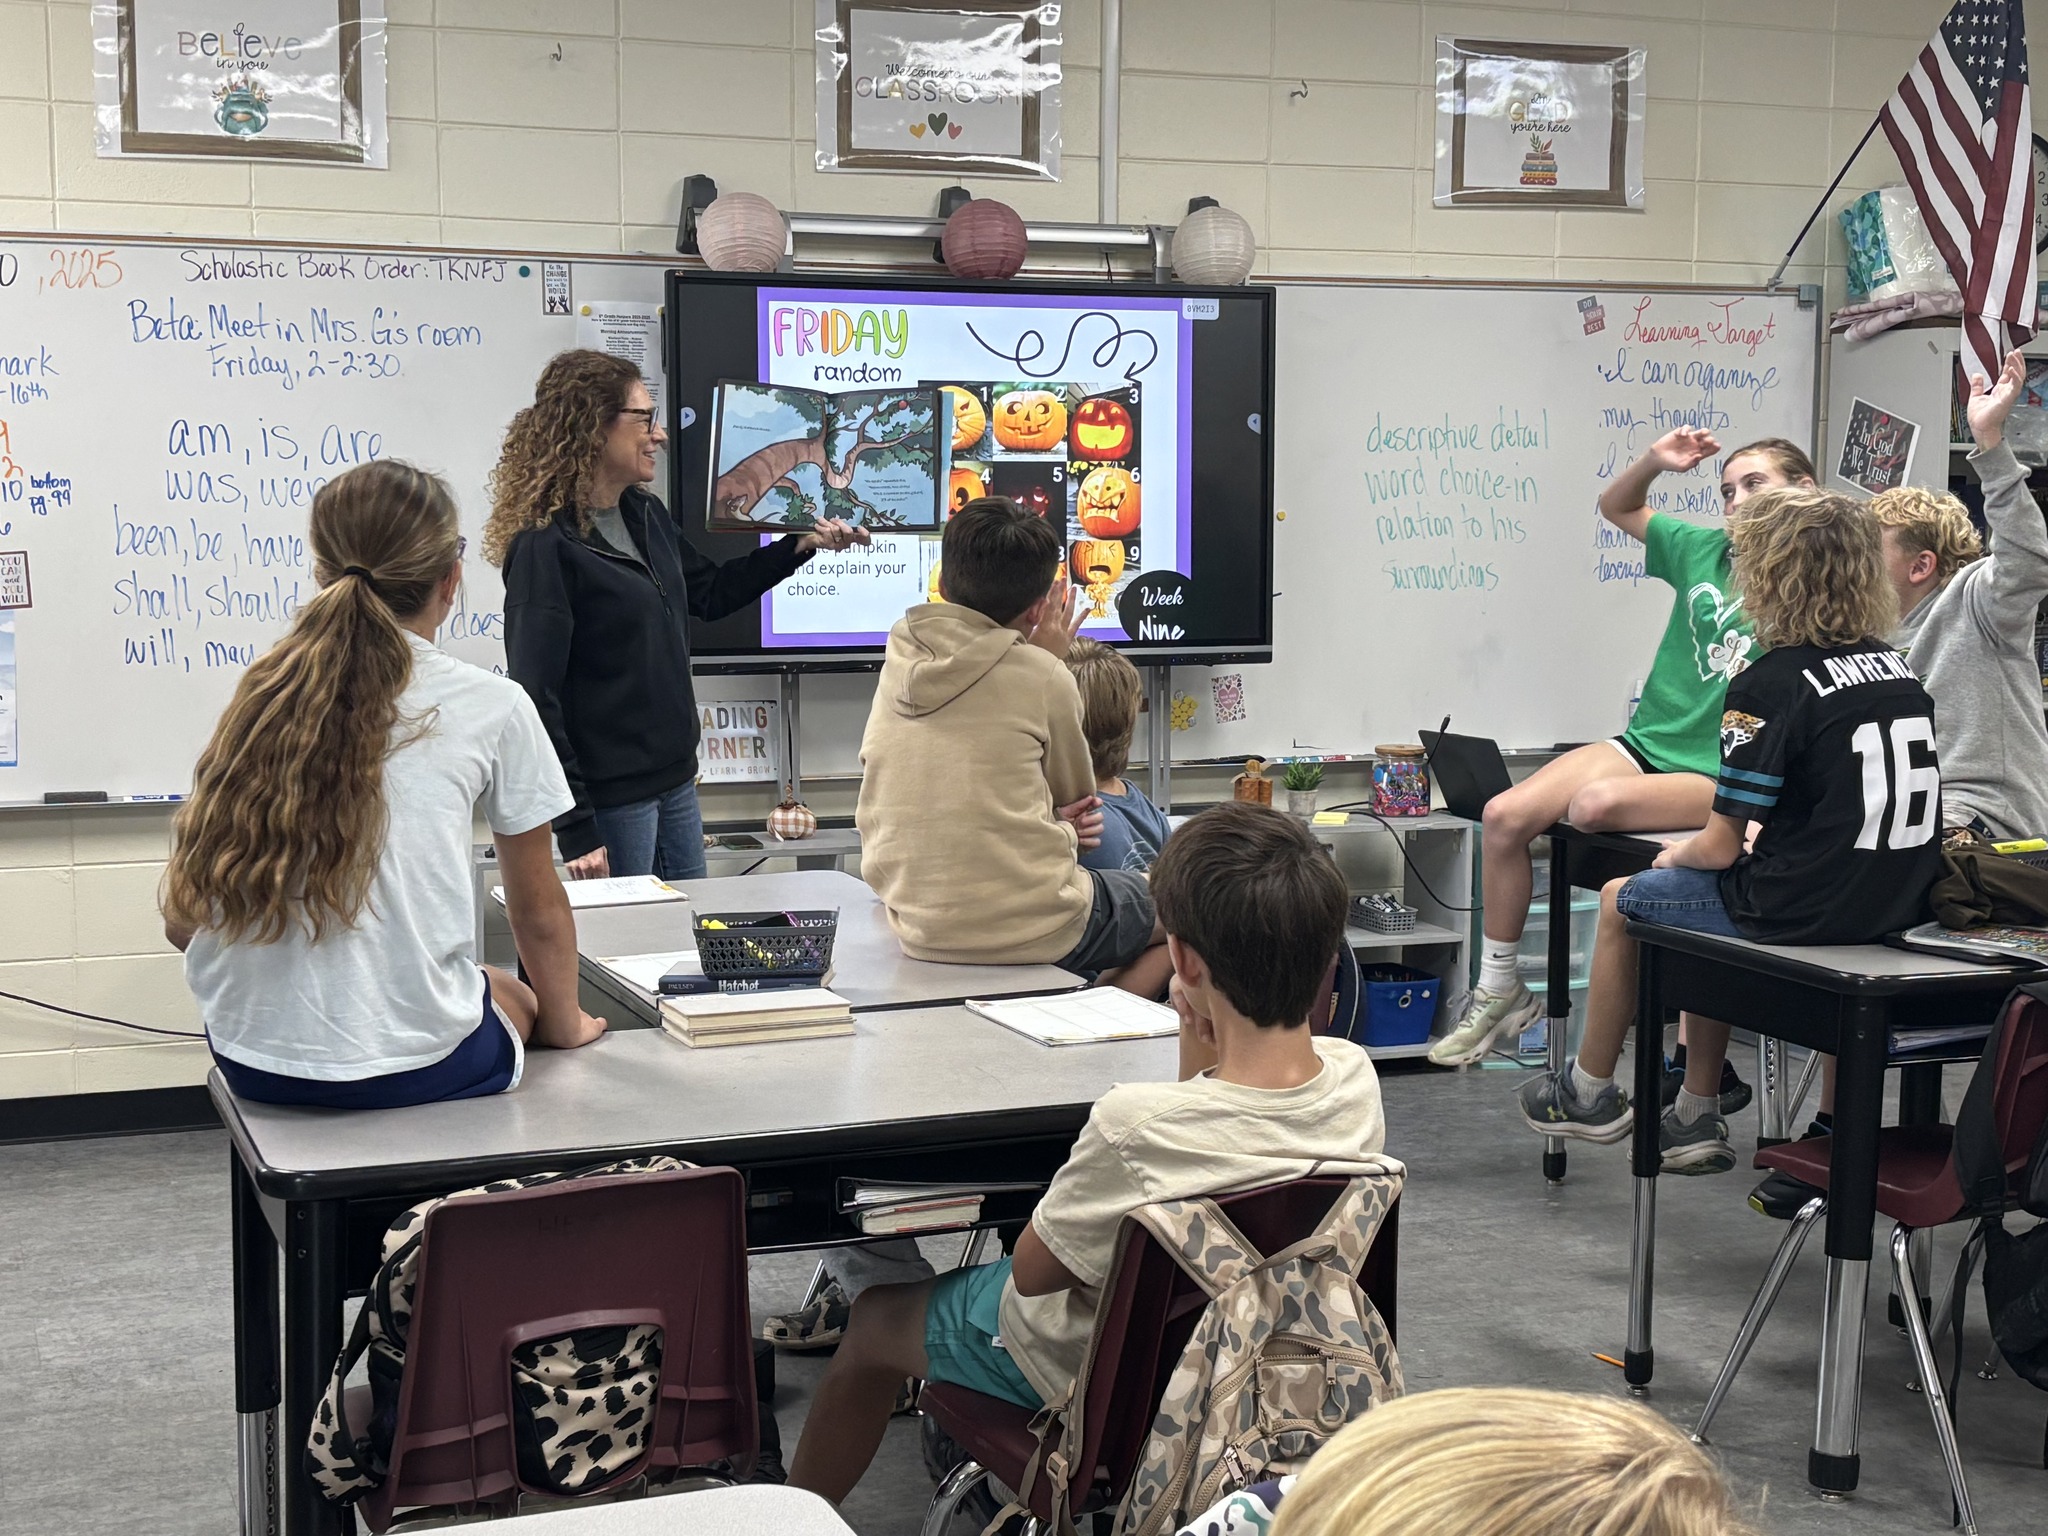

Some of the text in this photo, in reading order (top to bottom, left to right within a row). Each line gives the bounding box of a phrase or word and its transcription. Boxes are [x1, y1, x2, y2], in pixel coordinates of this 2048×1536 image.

[217, 58, 269, 73] in you
[1547, 121, 1572, 133] here
[2038, 171, 2046, 184] 2
[2036, 214, 2042, 226] 4
[181, 250, 288, 282] Scholastic
[299, 253, 356, 279] Book
[365, 253, 429, 280] Order:
[1583, 300, 1592, 309] DO
[209, 303, 274, 341] Meet
[276, 315, 303, 343] in
[310, 309, 366, 344] Mrs.
[418, 321, 481, 347] room
[774, 307, 908, 359] FRIDAY
[1587, 321, 1602, 333] BEST
[1624, 296, 1776, 357] Learning Target
[207, 343, 300, 390] Friday,
[814, 362, 902, 383] random
[980, 387, 988, 402] 1
[1056, 387, 1065, 402] 2
[1642, 359, 1680, 386] can
[1684, 361, 1780, 412] organize
[1130, 388, 1139, 404] 3
[1366, 405, 1549, 460] descriptive detail
[1602, 408, 1648, 450] my
[1859, 420, 1898, 457] In God
[1131, 466, 1140, 482] 6
[1851, 445, 1892, 484] We Trust
[31, 471, 71, 489] bottom
[980, 469, 991, 484] 4
[1053, 467, 1062, 482] 5
[1364, 455, 1429, 505] word
[260, 476, 327, 507] wer
[1674, 485, 1720, 517] skills
[1376, 501, 1527, 545] relation to his
[114, 504, 188, 566] been,
[0, 557, 21, 566] YOU
[1130, 546, 1140, 561] 9
[1, 567, 21, 575] CAN
[796, 560, 907, 578] nd explain your
[3, 585, 23, 594] YOU
[787, 581, 840, 596] choice.
[1140, 586, 1184, 607] Week
[2, 595, 26, 604] WILL
[1139, 614, 1186, 640] Nine
[1802, 651, 1920, 697] LAWRENC
[702, 706, 768, 729] ADING
[699, 736, 766, 759] RNER
[710, 766, 770, 775] LEARN GROW
[1852, 717, 1940, 850] 16
[718, 979, 760, 992] Hatchet
